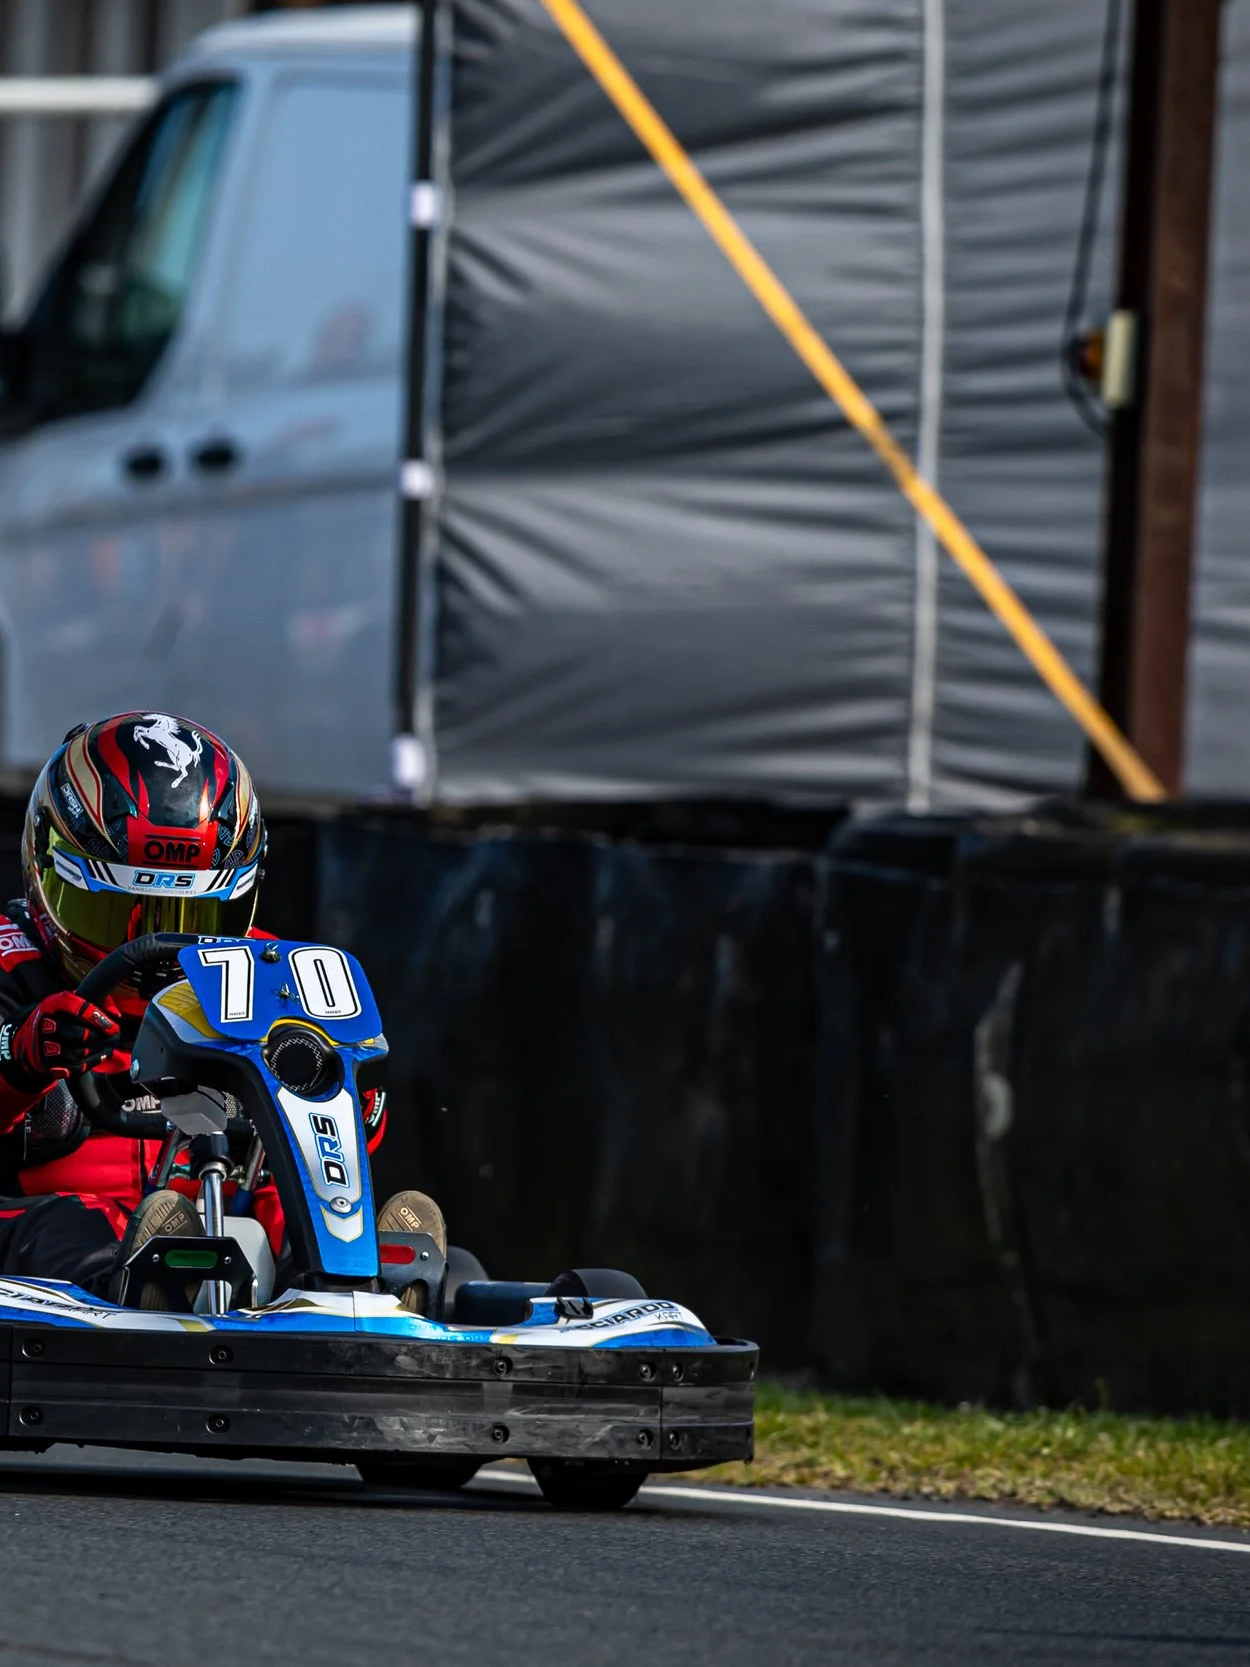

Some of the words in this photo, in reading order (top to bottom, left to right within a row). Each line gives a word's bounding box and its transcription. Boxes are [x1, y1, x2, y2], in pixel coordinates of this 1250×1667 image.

[143, 840, 201, 862] OMP
[133, 870, 195, 889] DRS
[309, 1113, 349, 1187] DRS
[164, 1213, 185, 1233] OMP
[400, 1207, 419, 1228] OMP
[655, 1311, 683, 1321] KART
